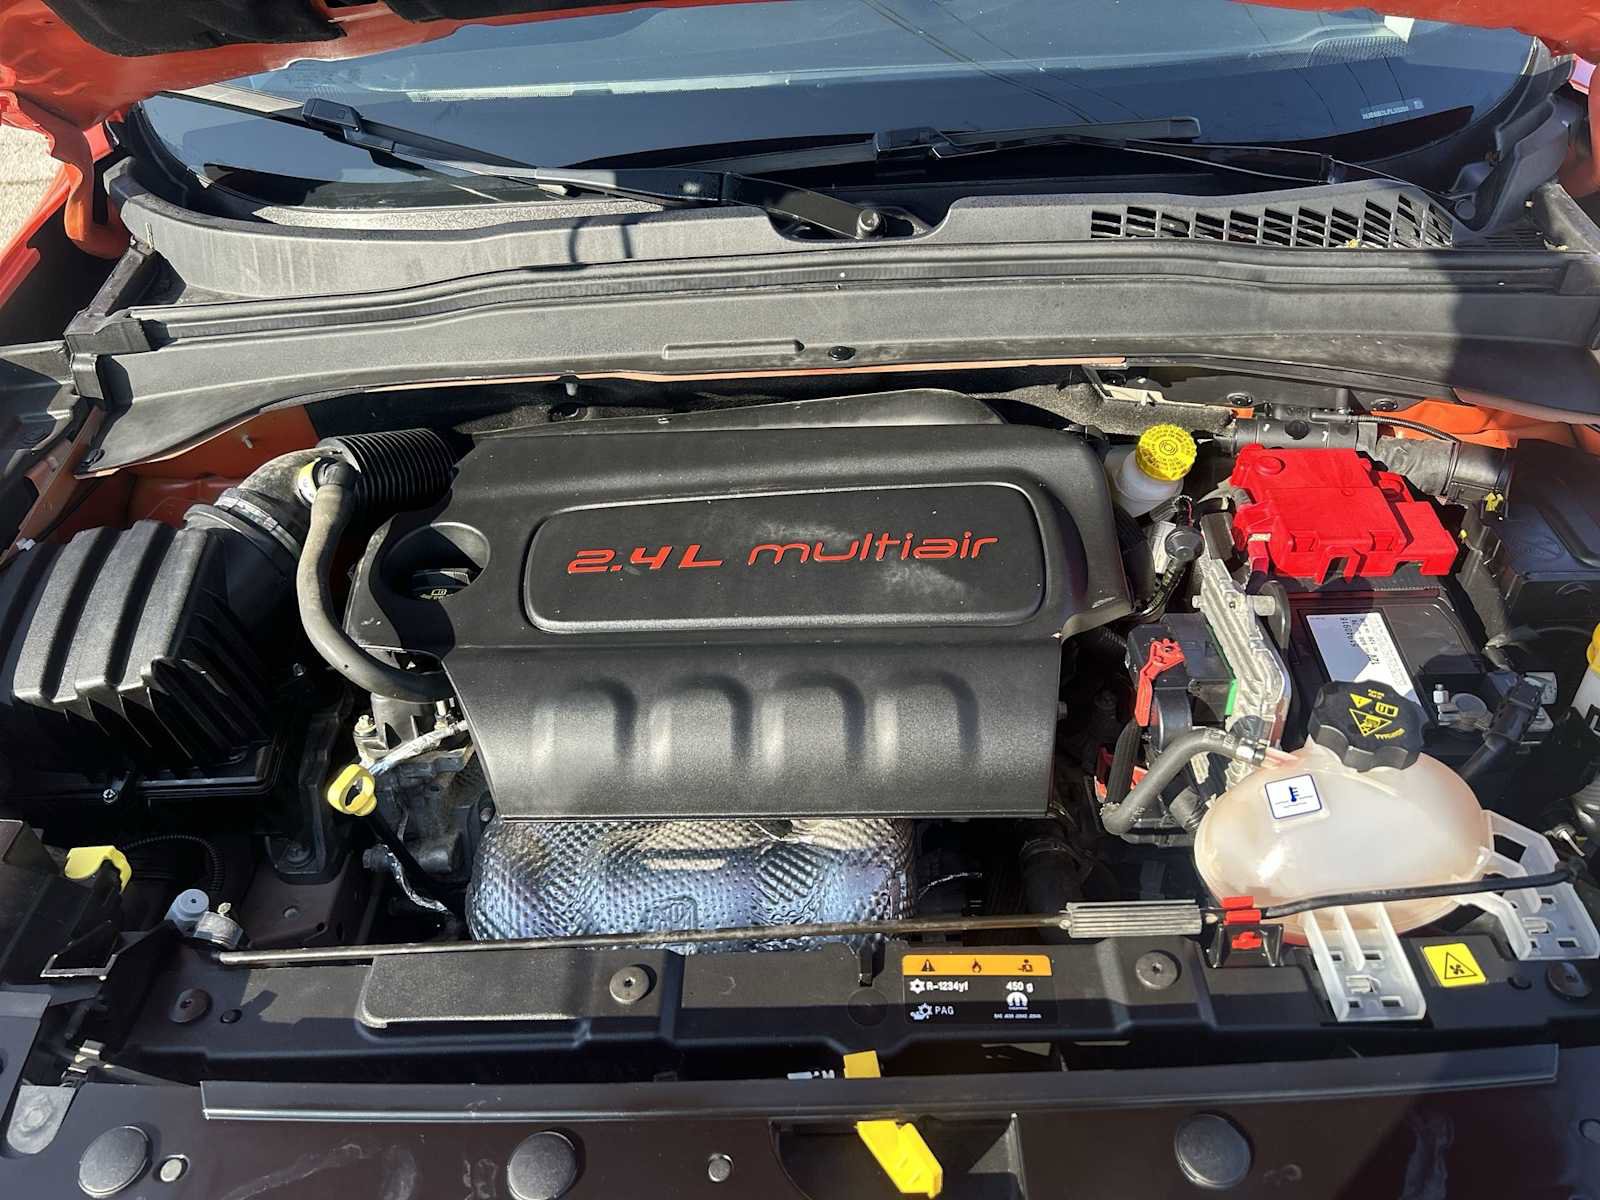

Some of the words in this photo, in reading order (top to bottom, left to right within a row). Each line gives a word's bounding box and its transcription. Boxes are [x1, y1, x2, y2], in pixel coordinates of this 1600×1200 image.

[747, 530, 999, 566] multiair
[1005, 980, 1024, 991] 450
[934, 1005, 955, 1016] PAG
